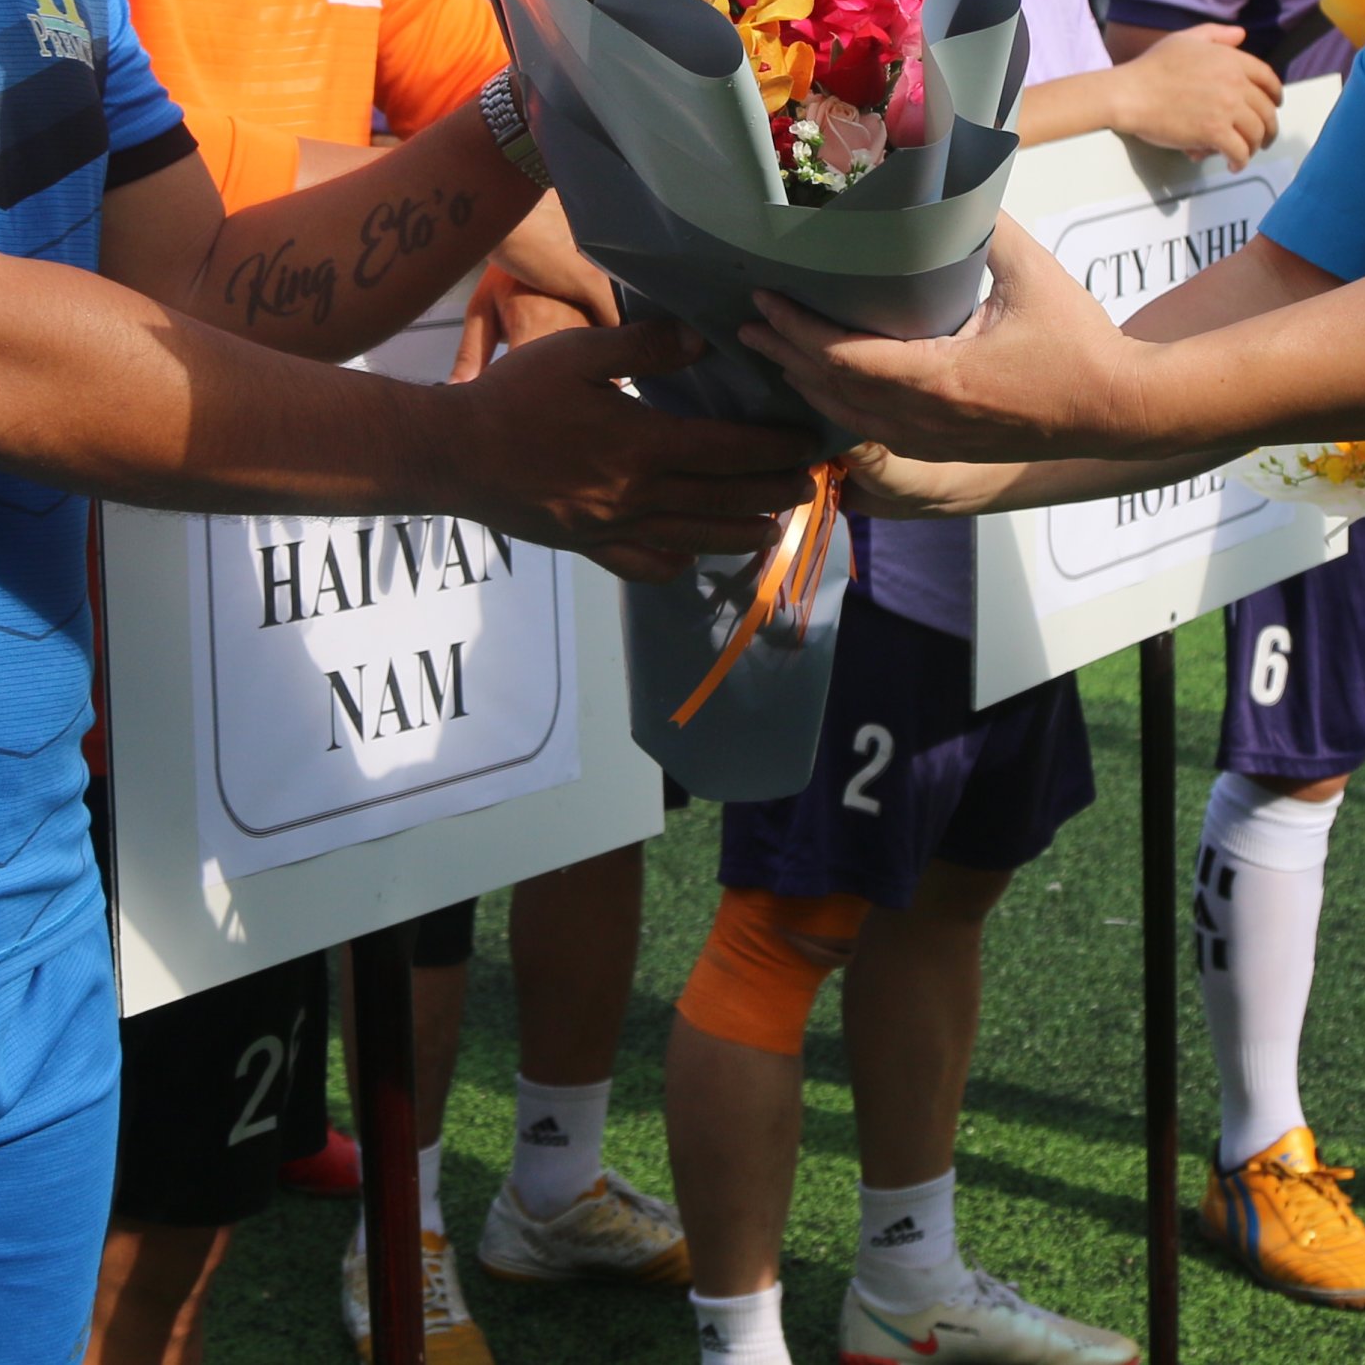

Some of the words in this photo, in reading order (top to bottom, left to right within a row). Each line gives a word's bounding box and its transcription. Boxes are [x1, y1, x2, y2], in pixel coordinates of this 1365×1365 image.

[225, 239, 341, 326] King
[1085, 244, 1153, 304] CTY
[324, 641, 470, 752] NAM
[1248, 624, 1293, 707] 6
[842, 723, 895, 817] 2
